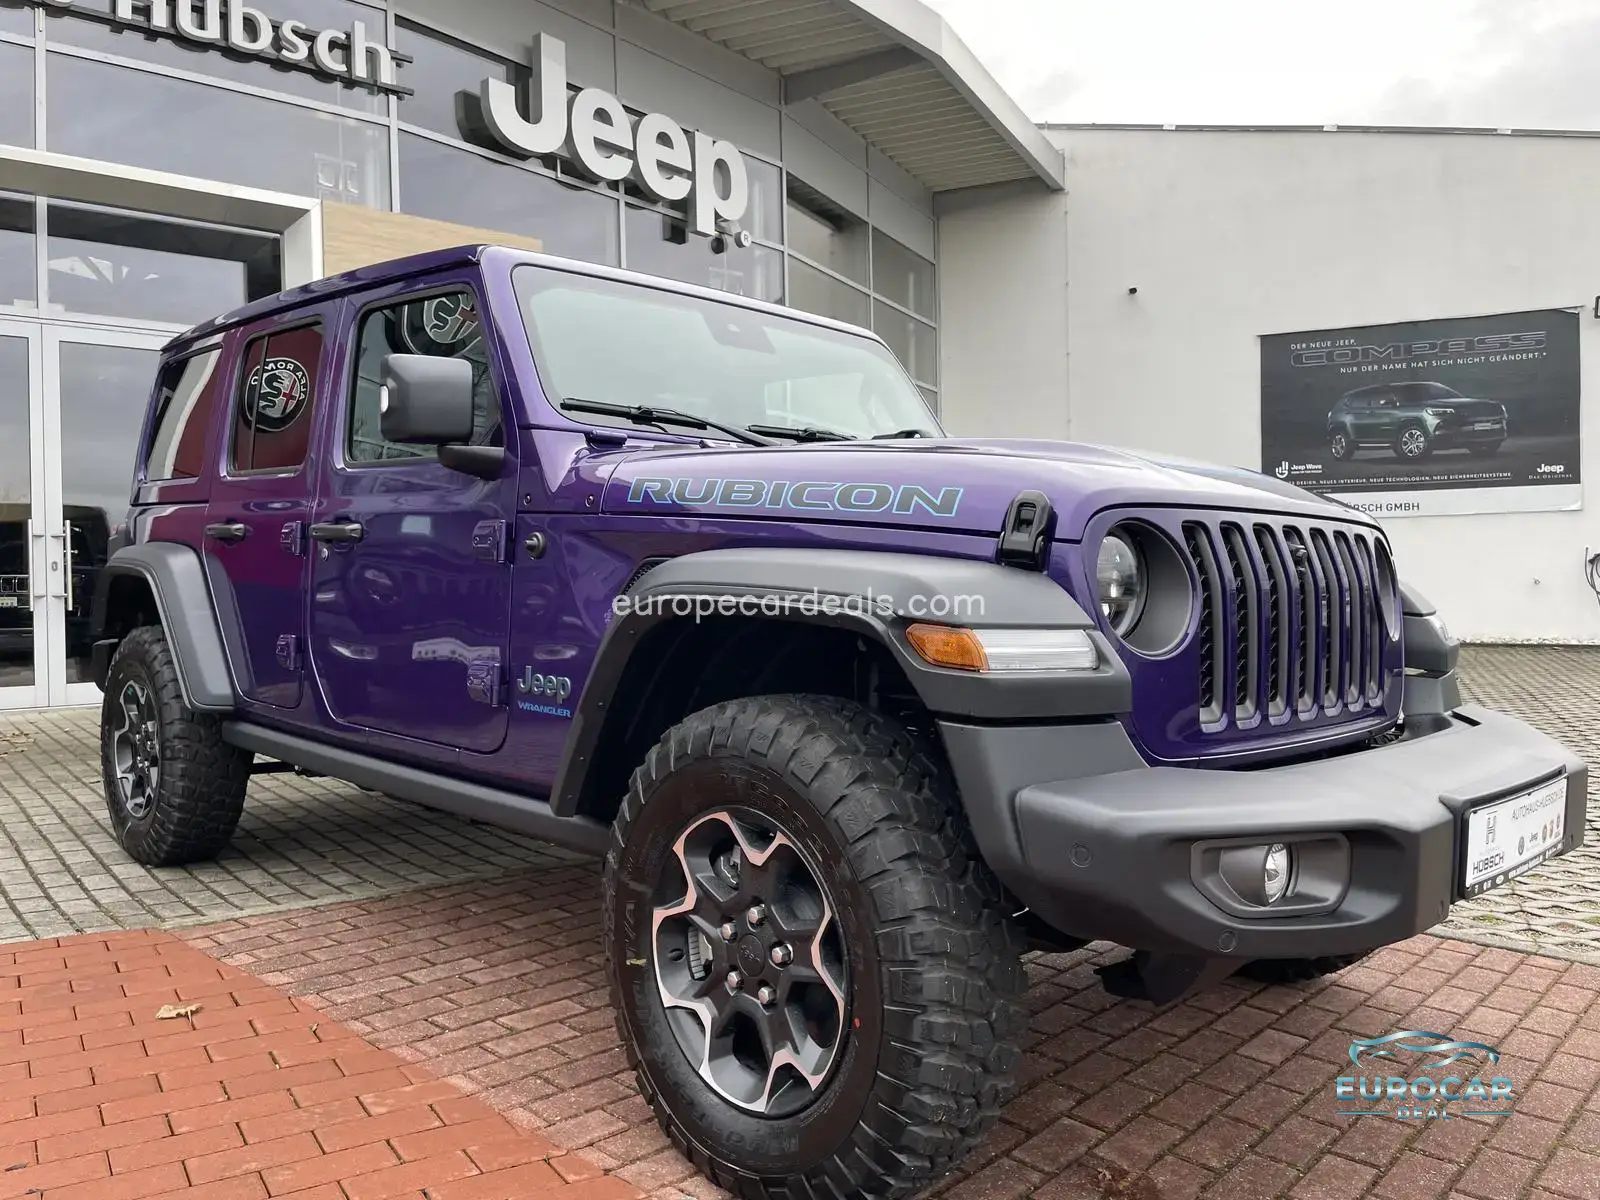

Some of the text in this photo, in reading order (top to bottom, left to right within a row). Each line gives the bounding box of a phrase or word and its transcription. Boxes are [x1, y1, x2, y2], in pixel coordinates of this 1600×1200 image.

[481, 32, 748, 236] Jeep
[1290, 342, 1307, 350] DER
[1310, 340, 1332, 348] NEUE
[1290, 331, 1546, 367] COMPASS
[1340, 366, 1358, 374] NUR
[1361, 364, 1378, 372] DER
[1382, 362, 1407, 370] NAME
[1411, 360, 1428, 368] HAT
[1432, 359, 1453, 367] SICH
[1457, 356, 1486, 364] NICHT
[1536, 463, 1565, 474] Jeep
[627, 476, 964, 517] RUBICON
[1386, 502, 1420, 512] GMBH
[517, 665, 571, 705] Jeep
[517, 700, 572, 718] WRANGLER
